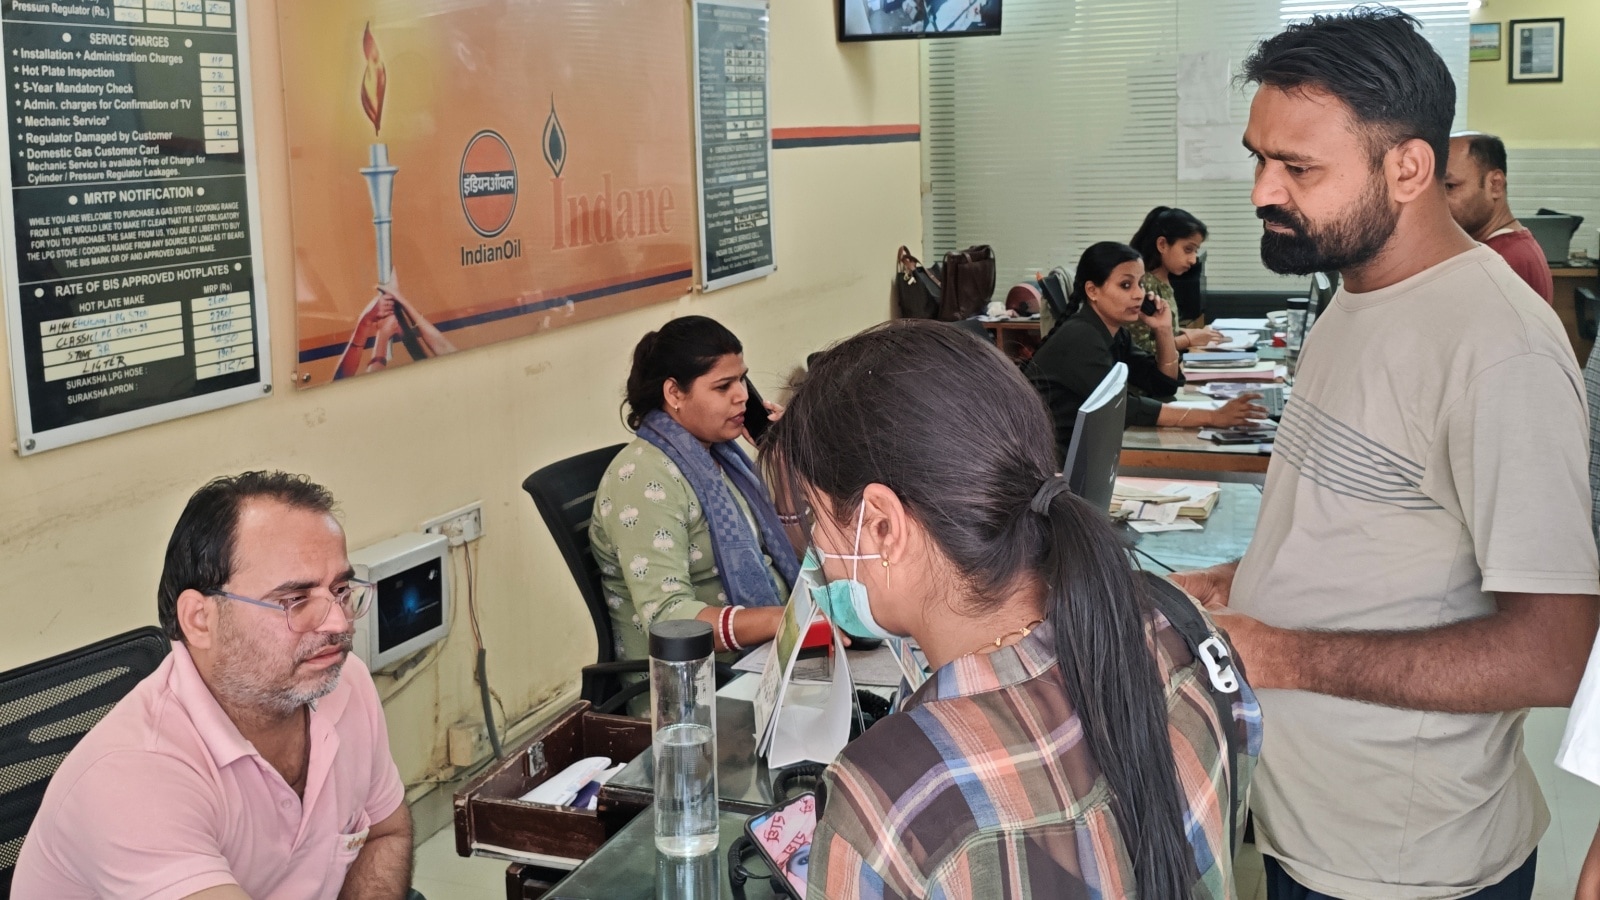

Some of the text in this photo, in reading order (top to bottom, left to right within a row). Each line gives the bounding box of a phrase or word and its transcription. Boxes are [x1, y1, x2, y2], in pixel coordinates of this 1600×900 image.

[12, 0, 49, 13] Pressure
[51, 3, 90, 16] Regulator
[91, 6, 110, 18] (Rs.)
[90, 33, 169, 48] SERVICE CHARGES
[20, 48, 74, 60] Installation
[83, 50, 147, 62] Administration
[149, 52, 183, 66] Charges
[21, 65, 115, 78] Hot Plate Inspection
[23, 82, 134, 96] 5-Year Mandatory Check
[60, 99, 97, 112] charges
[99, 99, 112, 109] for
[113, 99, 168, 109] Confirmation
[169, 99, 179, 109] of
[179, 99, 191, 109] TV
[24, 116, 71, 127] Mechanic
[25, 130, 173, 146] Regulator Damaged by Customer
[26, 144, 160, 159] Domestic Gas Customer Card
[26, 155, 206, 171] Mechanic Service is available Free of Charge for
[27, 173, 63, 185] Cylinder
[69, 171, 105, 181] Pressure
[106, 169, 143, 181] Regulator
[463, 173, 515, 195] इंडियनऑयल
[84, 186, 194, 204] MRTP NOTIFICATION
[550, 171, 675, 250] Indane
[461, 239, 521, 267] IndianOil
[55, 264, 229, 297] RATE OF BIS APPROVED HOTPLATES
[203, 284, 218, 294] MRP
[79, 294, 145, 312] HOT PLATE MAKE
[66, 367, 144, 389] SURAKSHA LPG HOSE
[67, 383, 134, 404] SURAKSHA APRON
